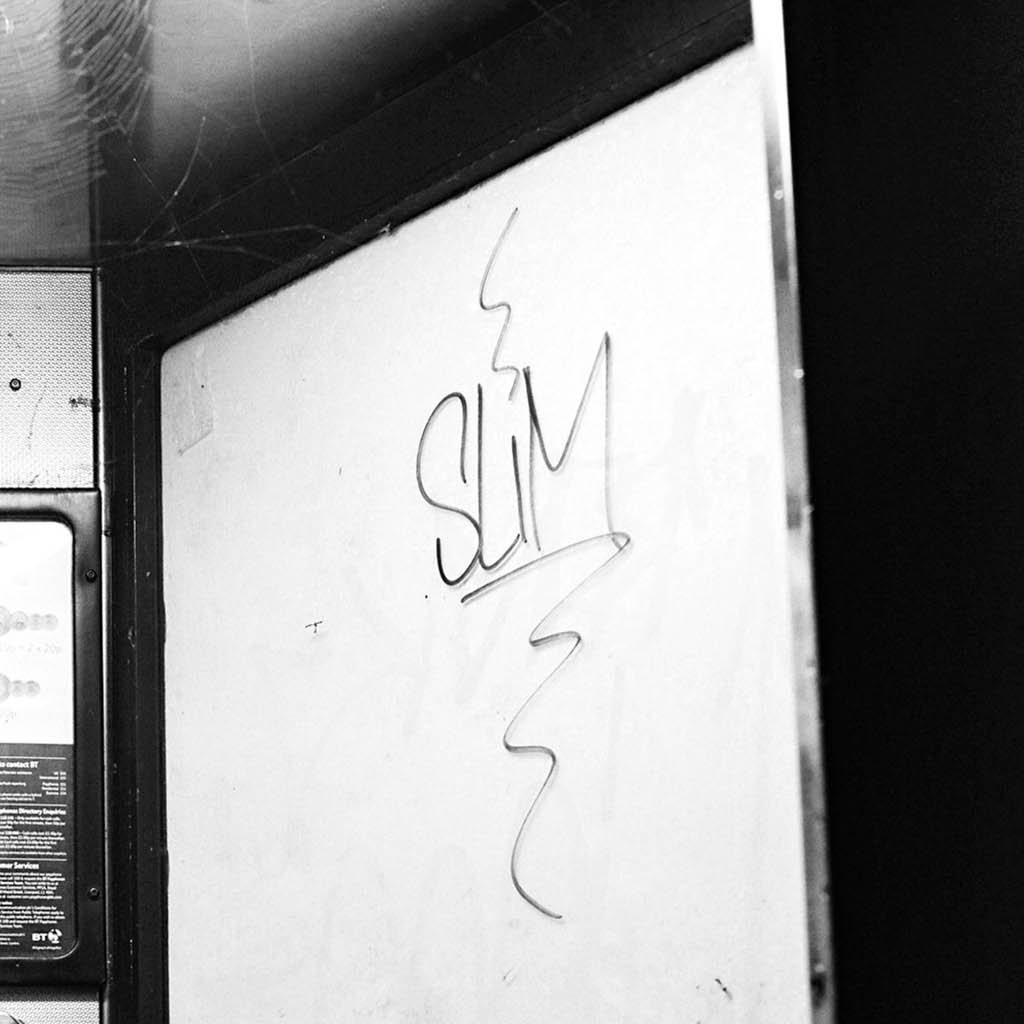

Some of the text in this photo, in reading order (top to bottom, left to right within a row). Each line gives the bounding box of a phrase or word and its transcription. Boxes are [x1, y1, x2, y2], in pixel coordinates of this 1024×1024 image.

[6, 760, 30, 769] contact
[30, 761, 39, 769] BT
[19, 807, 43, 816] Directory
[43, 807, 67, 816] Enquiries
[13, 861, 40, 871] Services
[31, 932, 48, 942] BT
